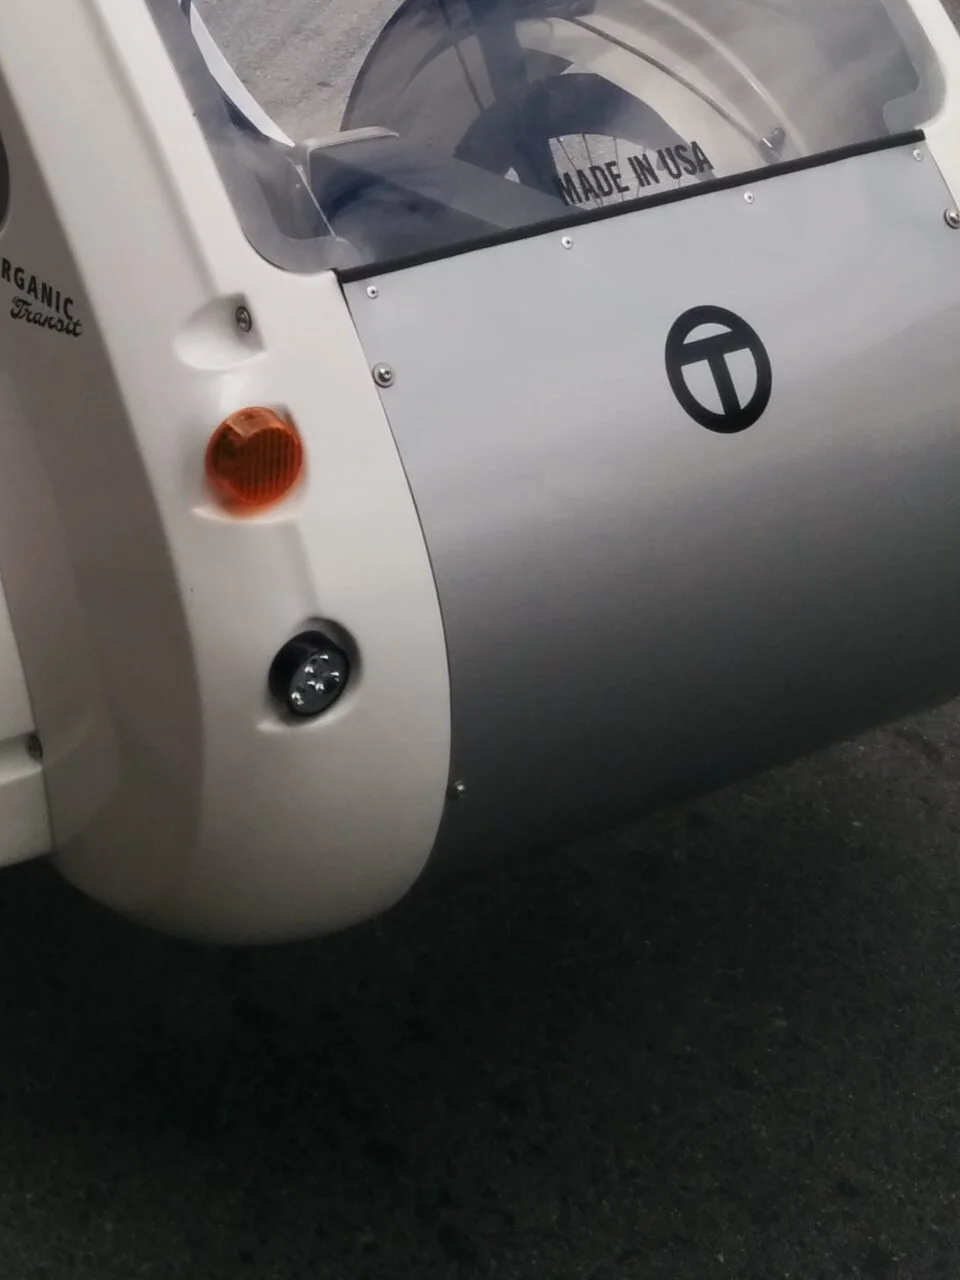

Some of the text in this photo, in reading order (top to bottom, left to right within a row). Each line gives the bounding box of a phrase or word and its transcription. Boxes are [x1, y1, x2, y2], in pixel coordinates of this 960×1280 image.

[554, 141, 715, 206] MADE IN USA
[10, 295, 83, 337] Transit
